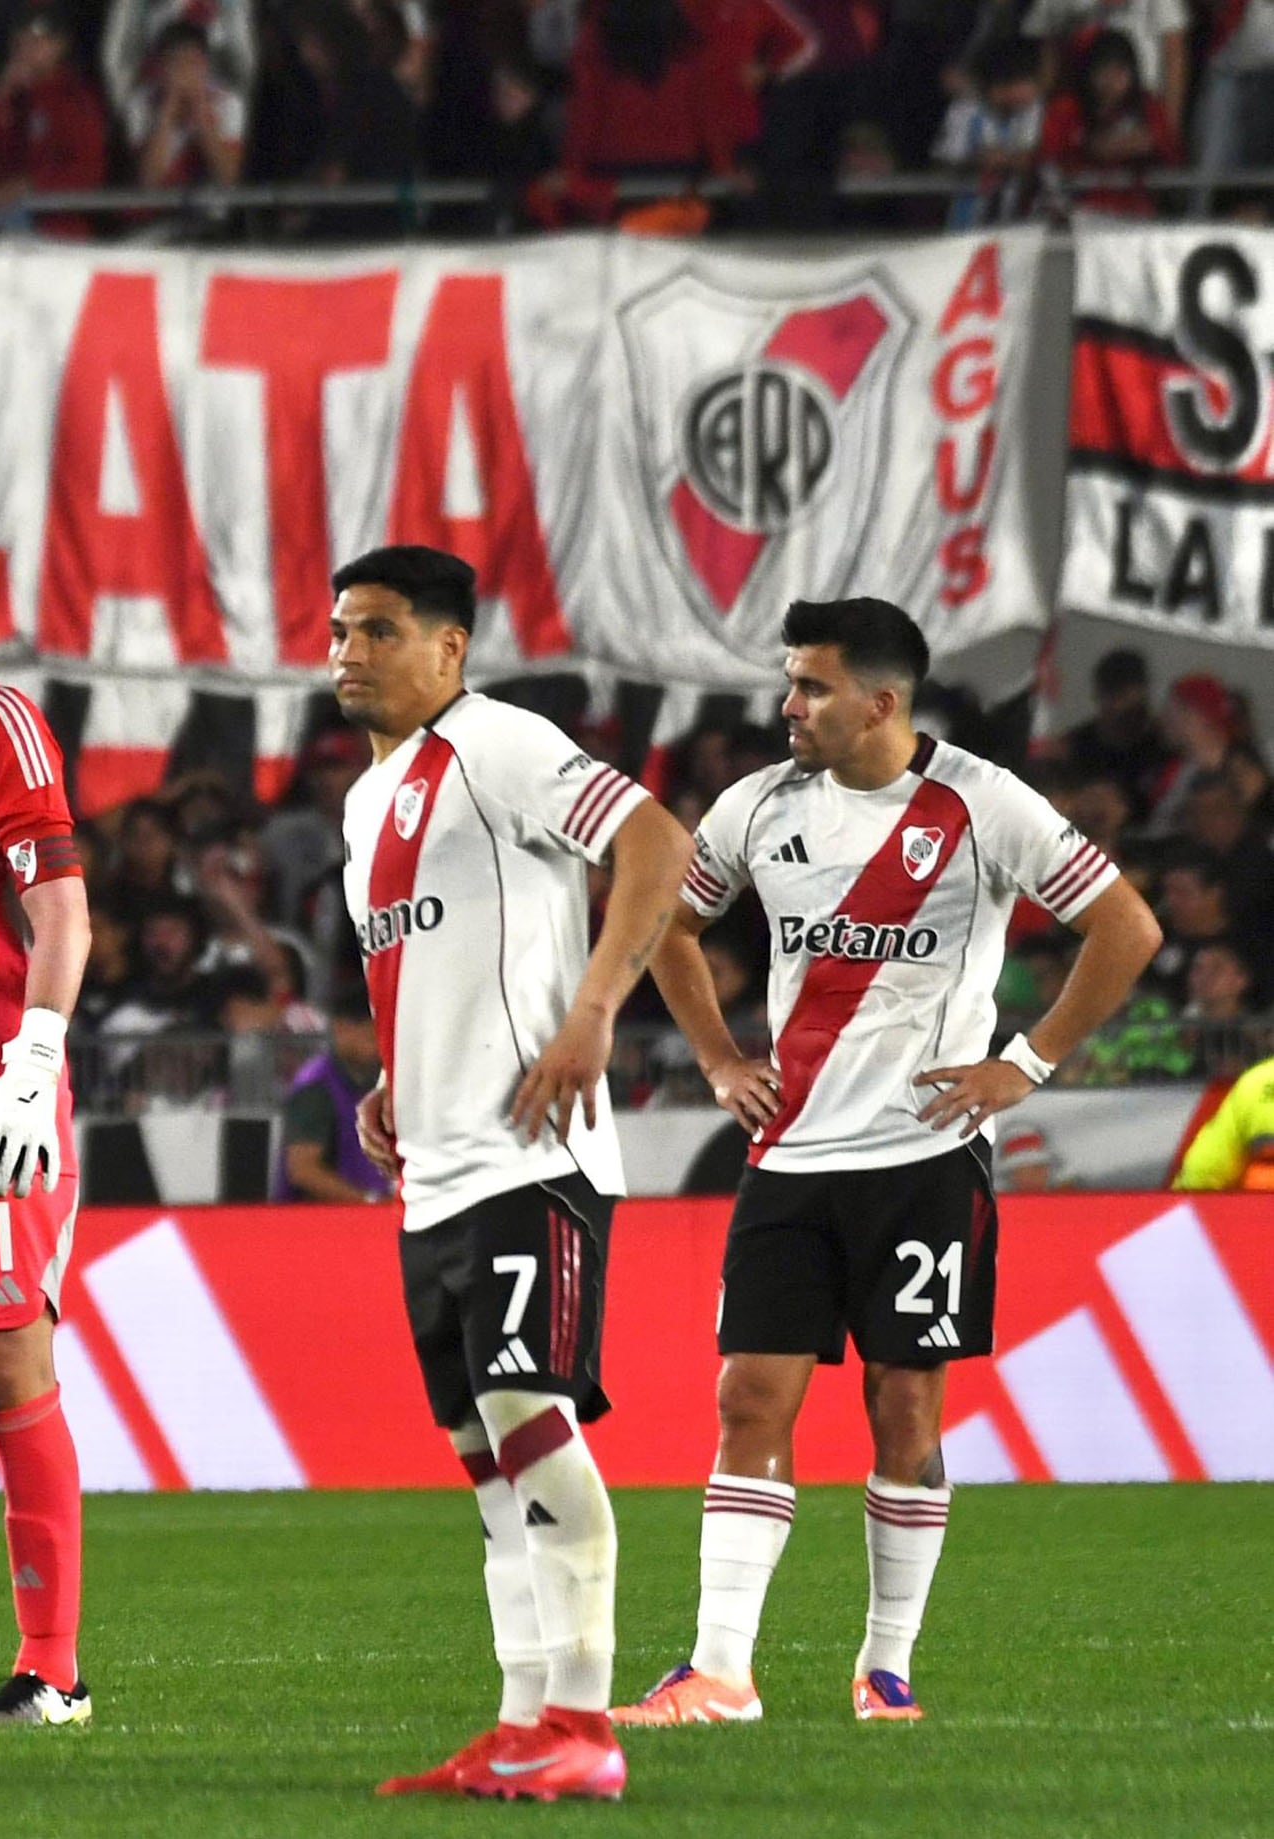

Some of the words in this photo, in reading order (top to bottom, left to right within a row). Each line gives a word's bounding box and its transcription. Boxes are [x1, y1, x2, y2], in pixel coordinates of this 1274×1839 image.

[930, 240, 1004, 611] AGUS
[779, 916, 938, 959] Betano
[492, 1254, 538, 1335] 7
[895, 1239, 963, 1315] 21
